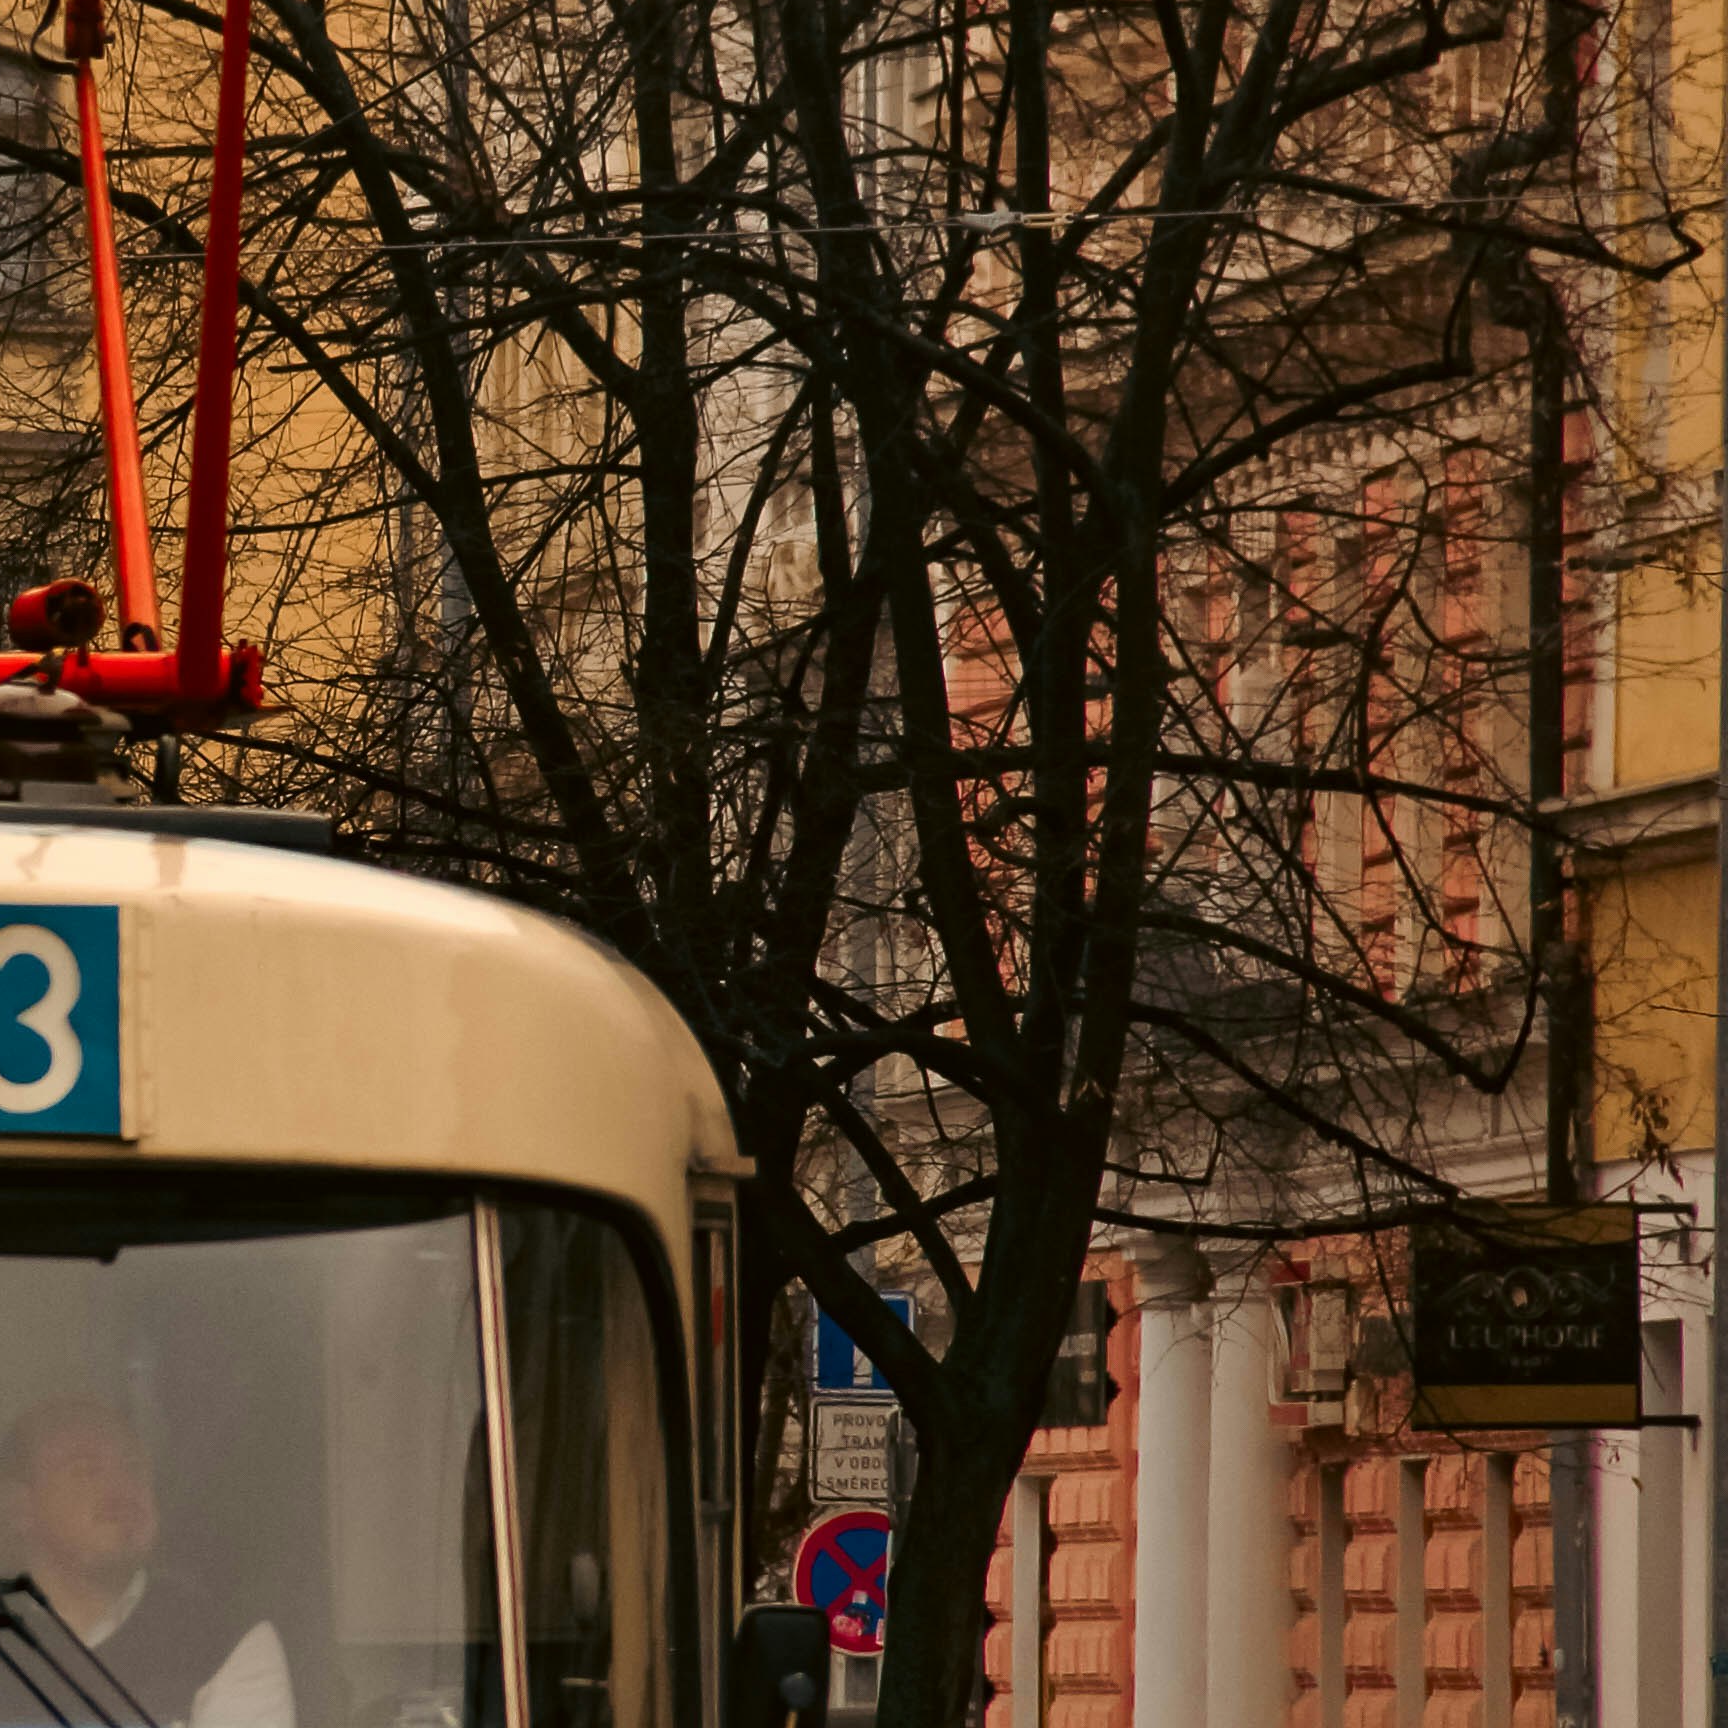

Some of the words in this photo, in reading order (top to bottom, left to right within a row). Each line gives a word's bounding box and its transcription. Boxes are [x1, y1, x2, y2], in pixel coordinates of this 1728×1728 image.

[832, 1413, 890, 1427] PROVO
[834, 1456, 845, 1469] V
[849, 1455, 889, 1471] OBO
[826, 1474, 890, 1491] SMĚREC
